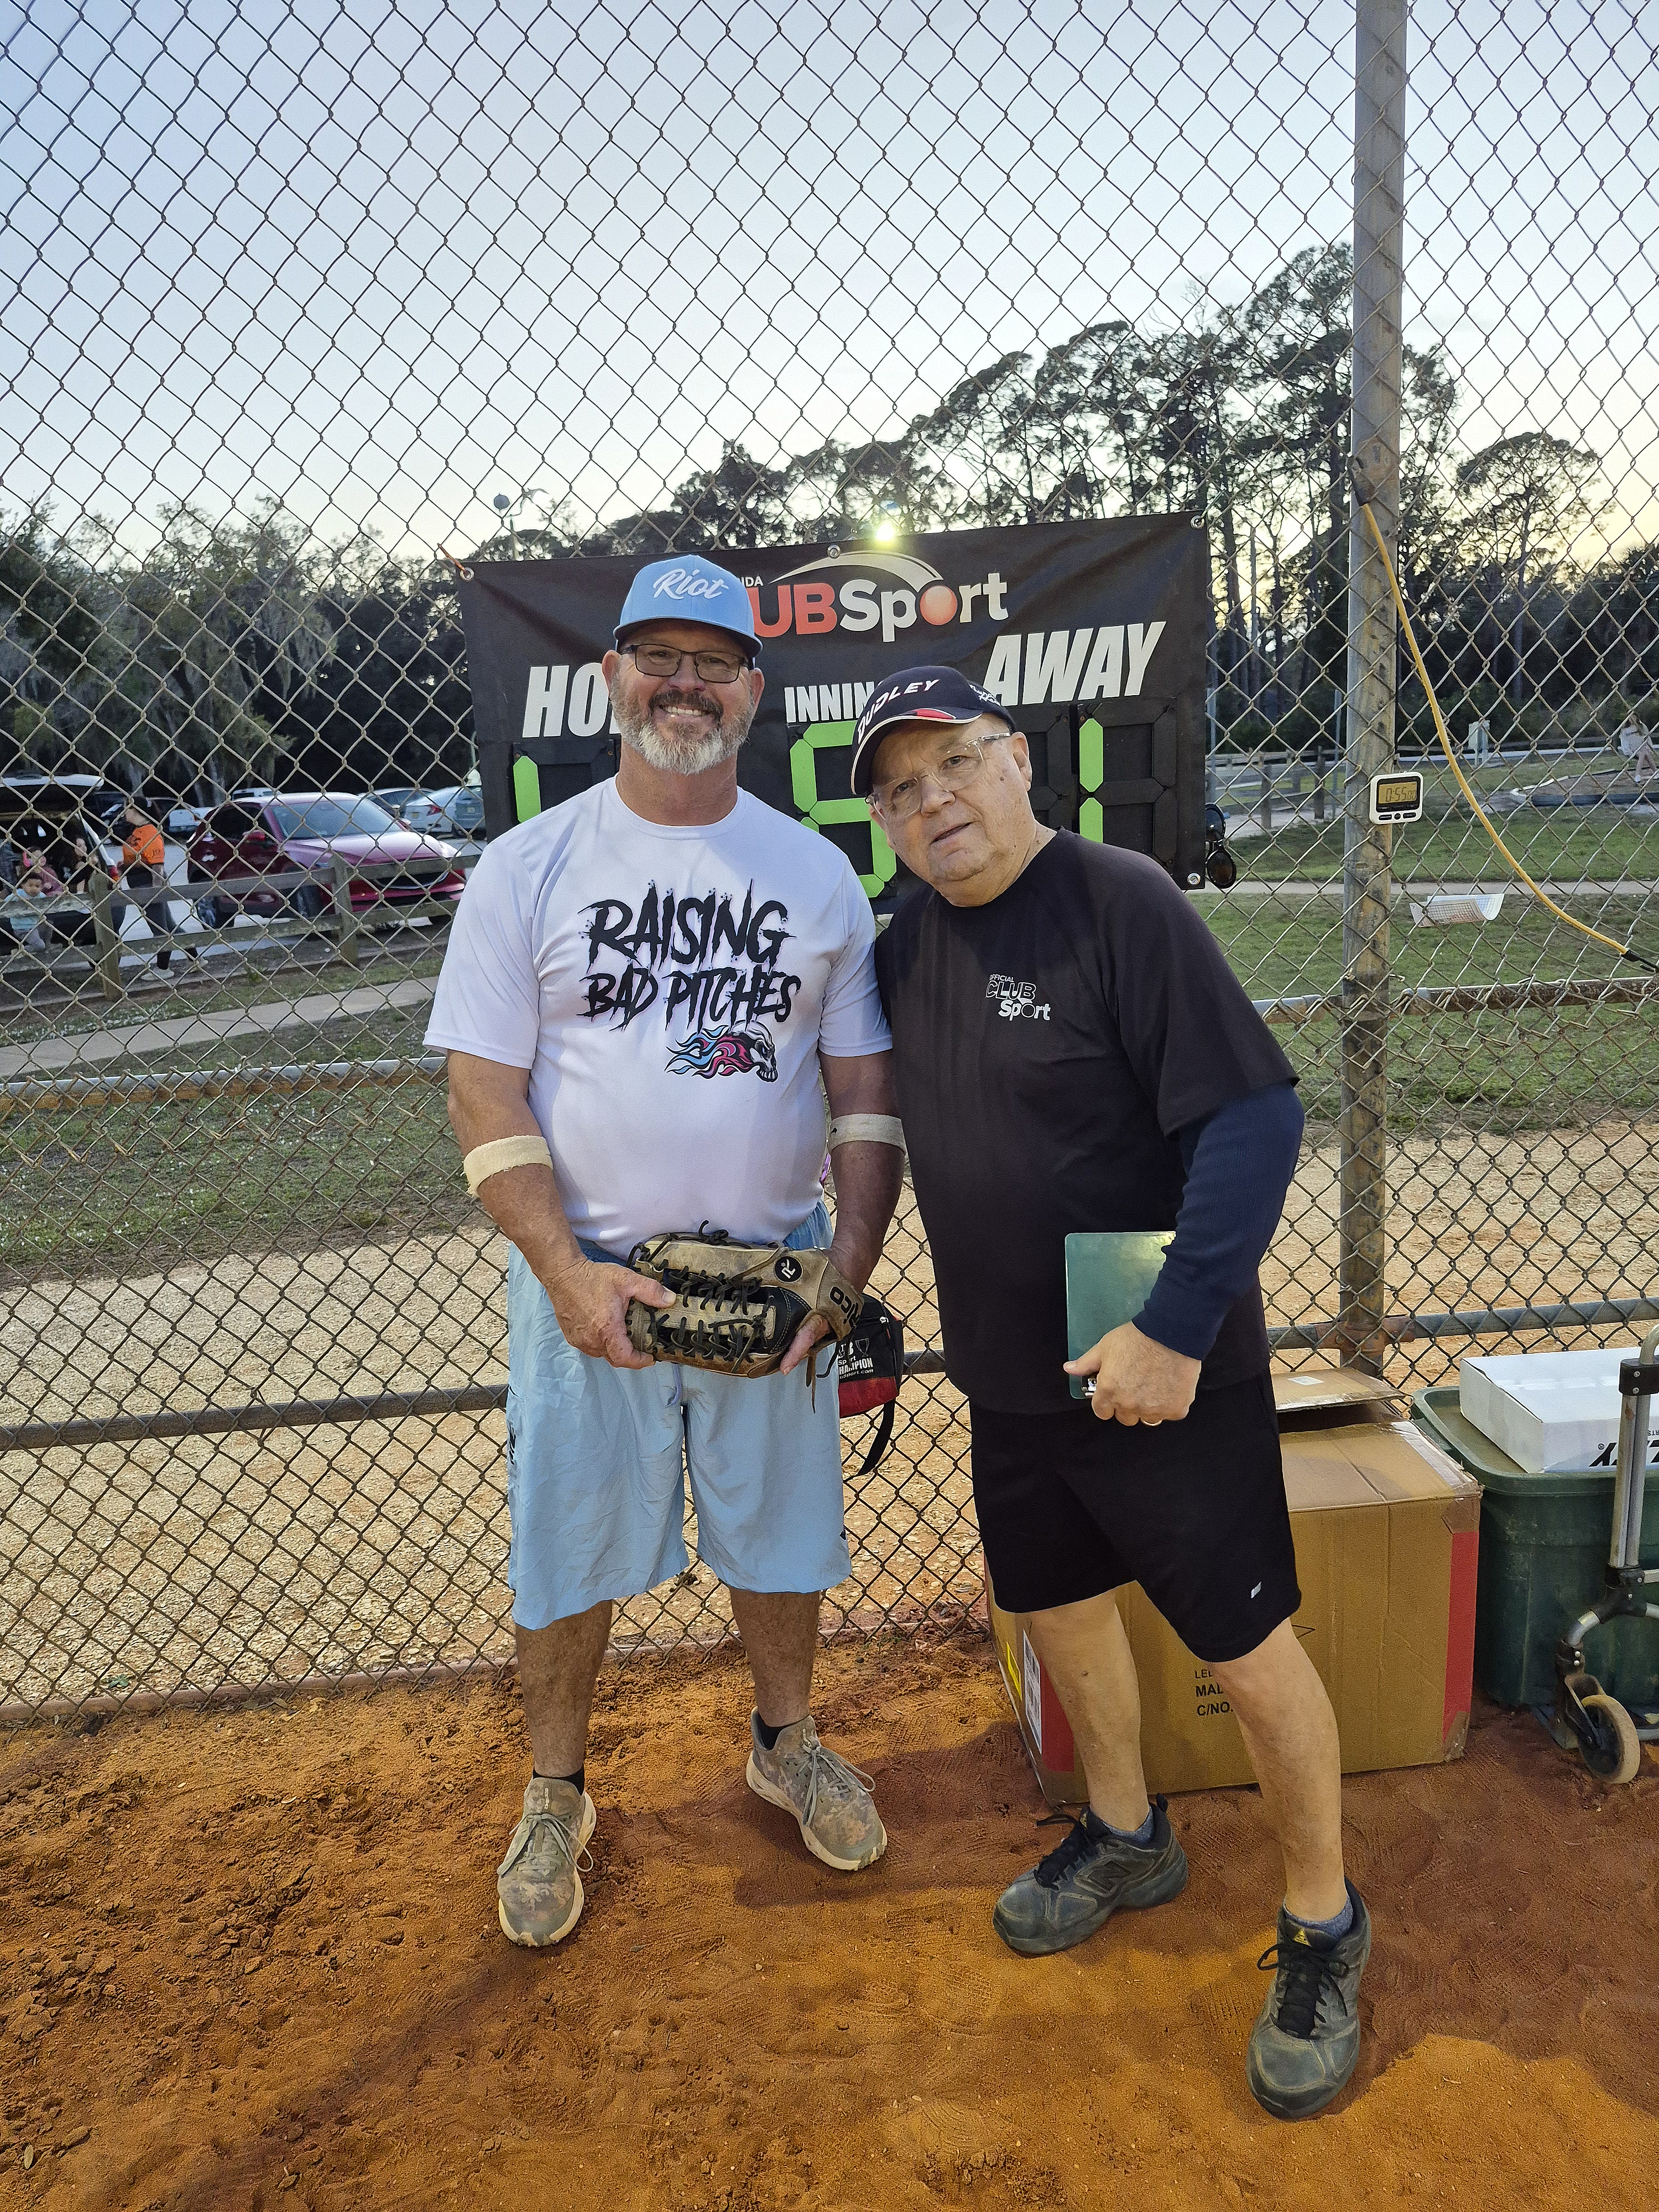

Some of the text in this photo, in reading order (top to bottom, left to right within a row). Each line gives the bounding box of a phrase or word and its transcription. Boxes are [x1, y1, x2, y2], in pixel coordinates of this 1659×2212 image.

[653, 568, 729, 599] Riot
[983, 621, 1167, 707] AWAY
[522, 662, 622, 738] HO
[784, 681, 881, 723] INNIN
[858, 679, 939, 745] DUDLEY
[577, 879, 796, 973] RAISING
[577, 961, 801, 1035] BAD PITCHES
[985, 980, 1036, 1001] CLUB
[998, 999, 1051, 1021] Sport
[838, 1357, 874, 1375] HAMPION
[1197, 1701, 1234, 1717] C/NO.
